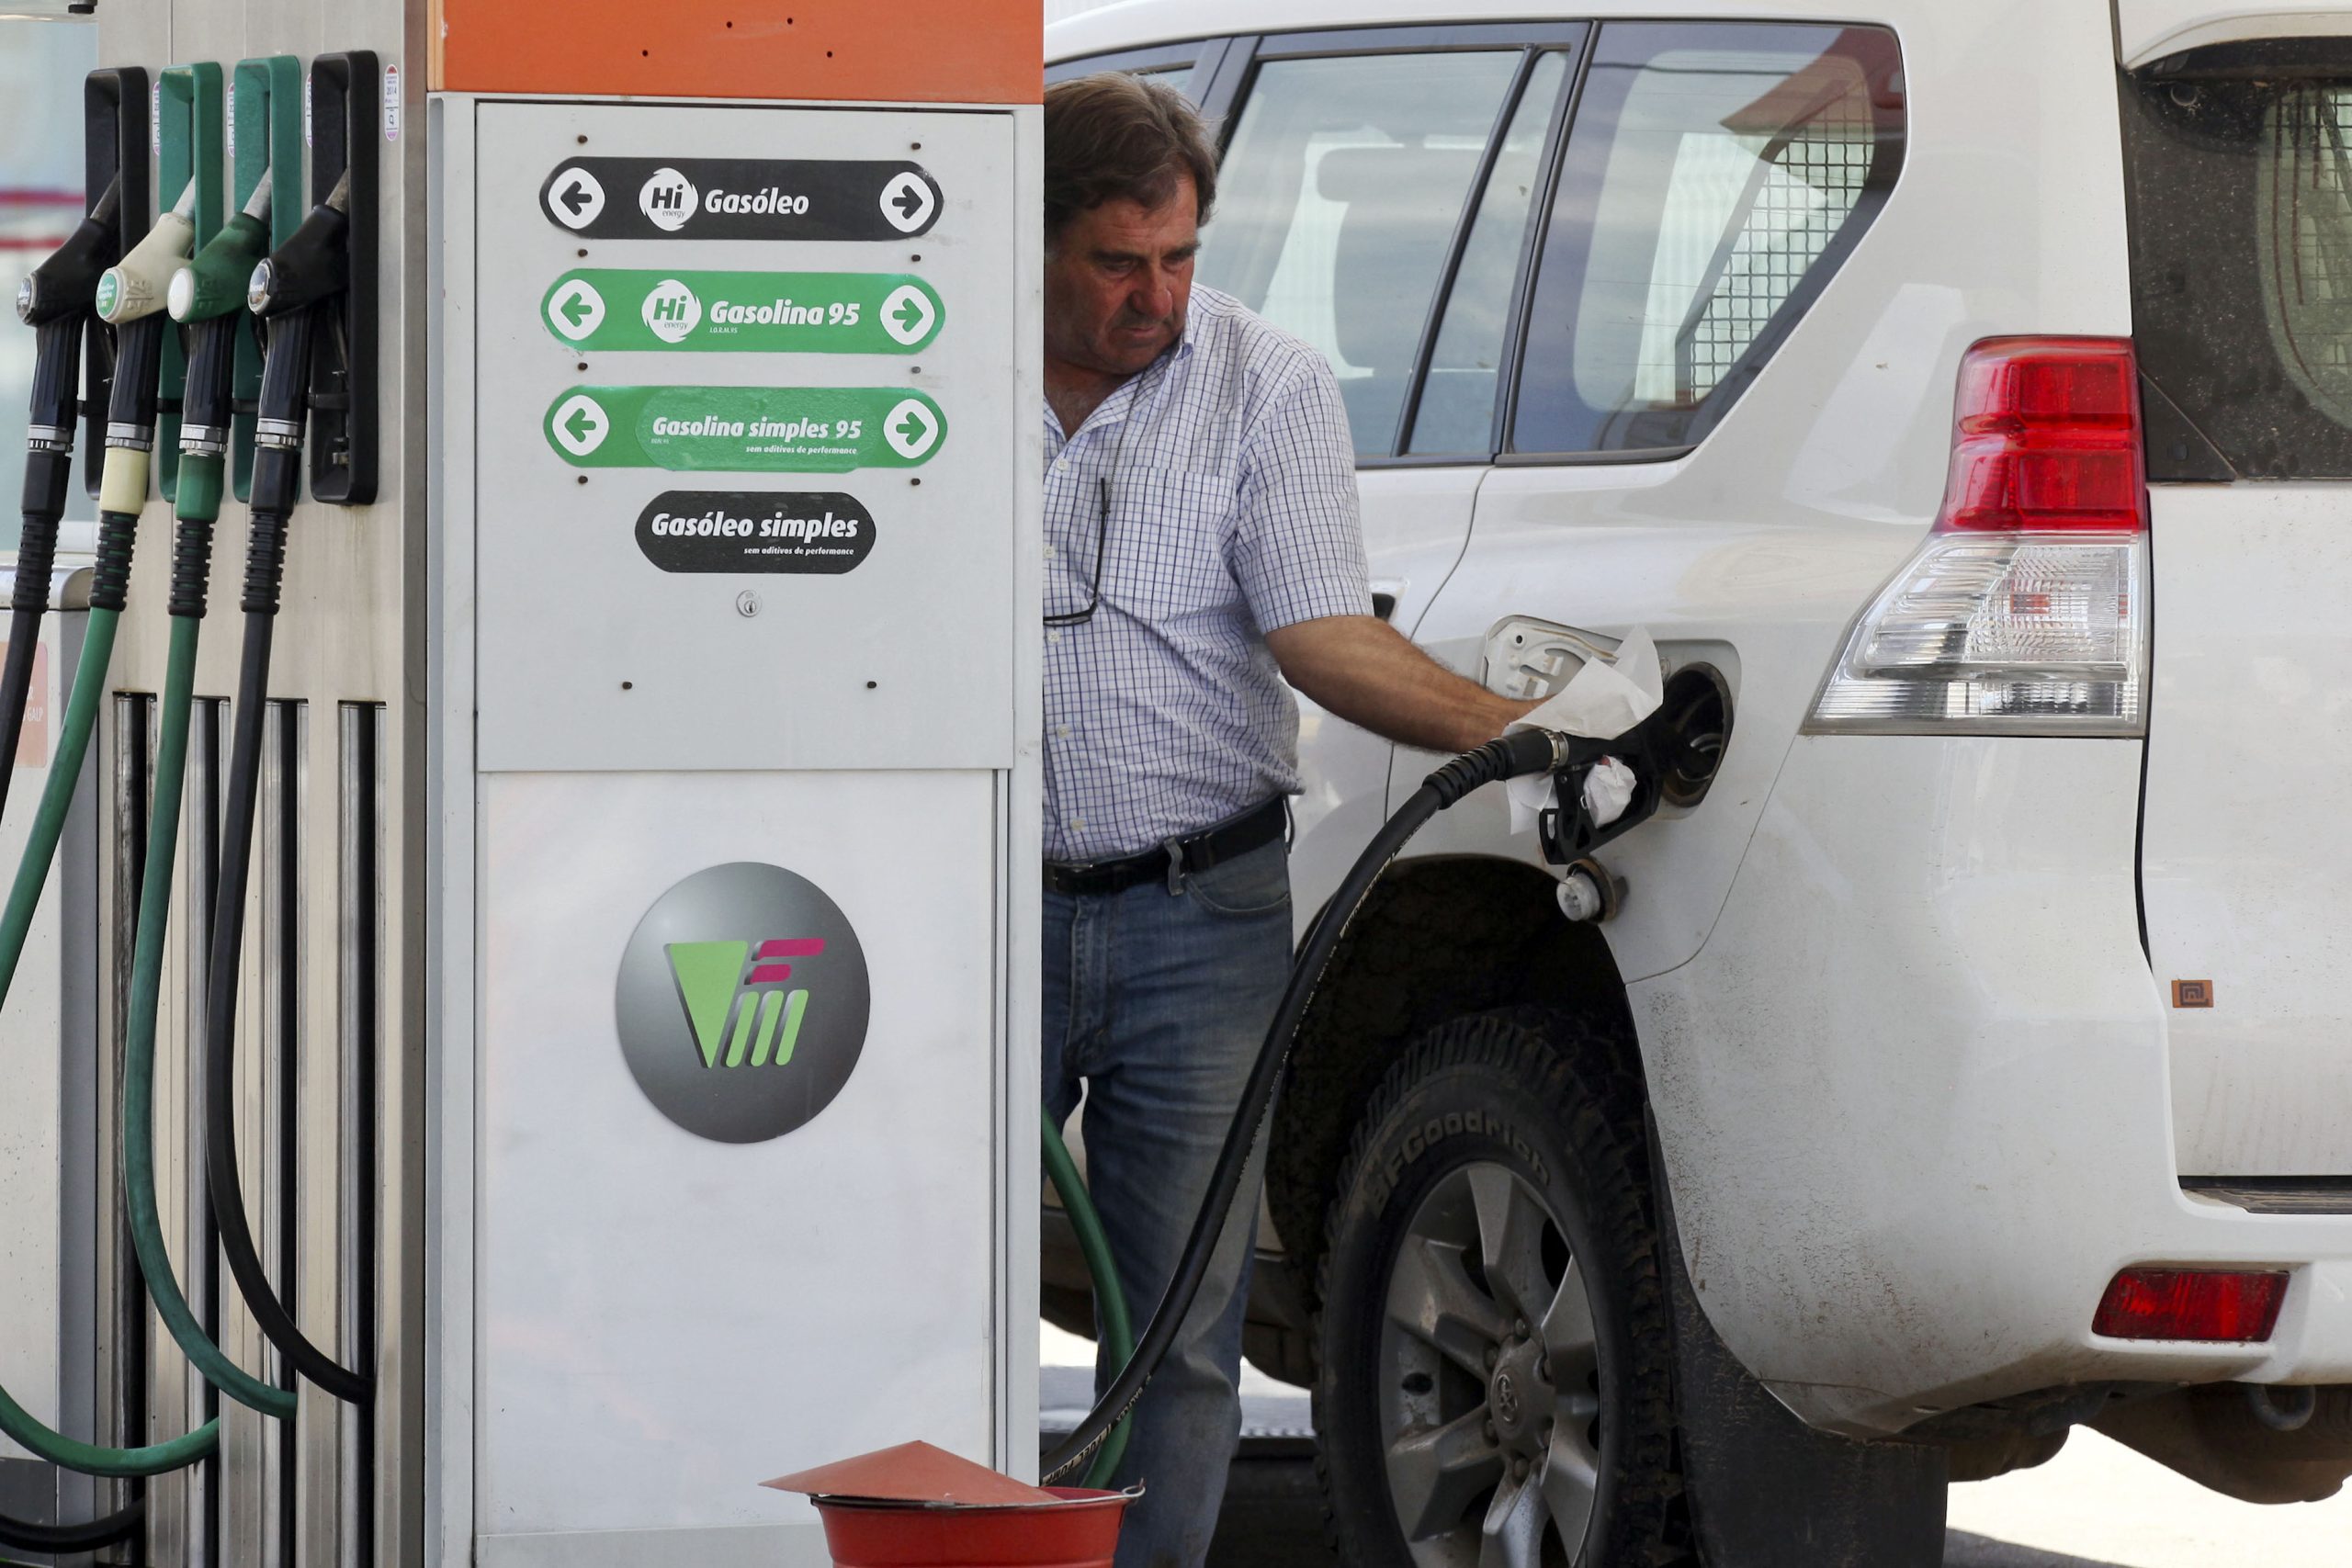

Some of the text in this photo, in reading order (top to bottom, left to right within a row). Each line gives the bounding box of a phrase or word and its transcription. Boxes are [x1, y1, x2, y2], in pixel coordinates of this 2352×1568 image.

[650, 184, 684, 209] Hi
[705, 186, 809, 215] Gasóleo
[662, 210, 685, 220] energy
[652, 295, 687, 321] Hi
[709, 299, 861, 326] Gasolina 95
[663, 321, 689, 332] energy
[652, 415, 862, 443] Gasolina simples 95
[745, 445, 857, 456] sem aditivos de performance
[651, 511, 859, 544] Gasóleo simples
[743, 546, 854, 557] sem aditivos de performance
